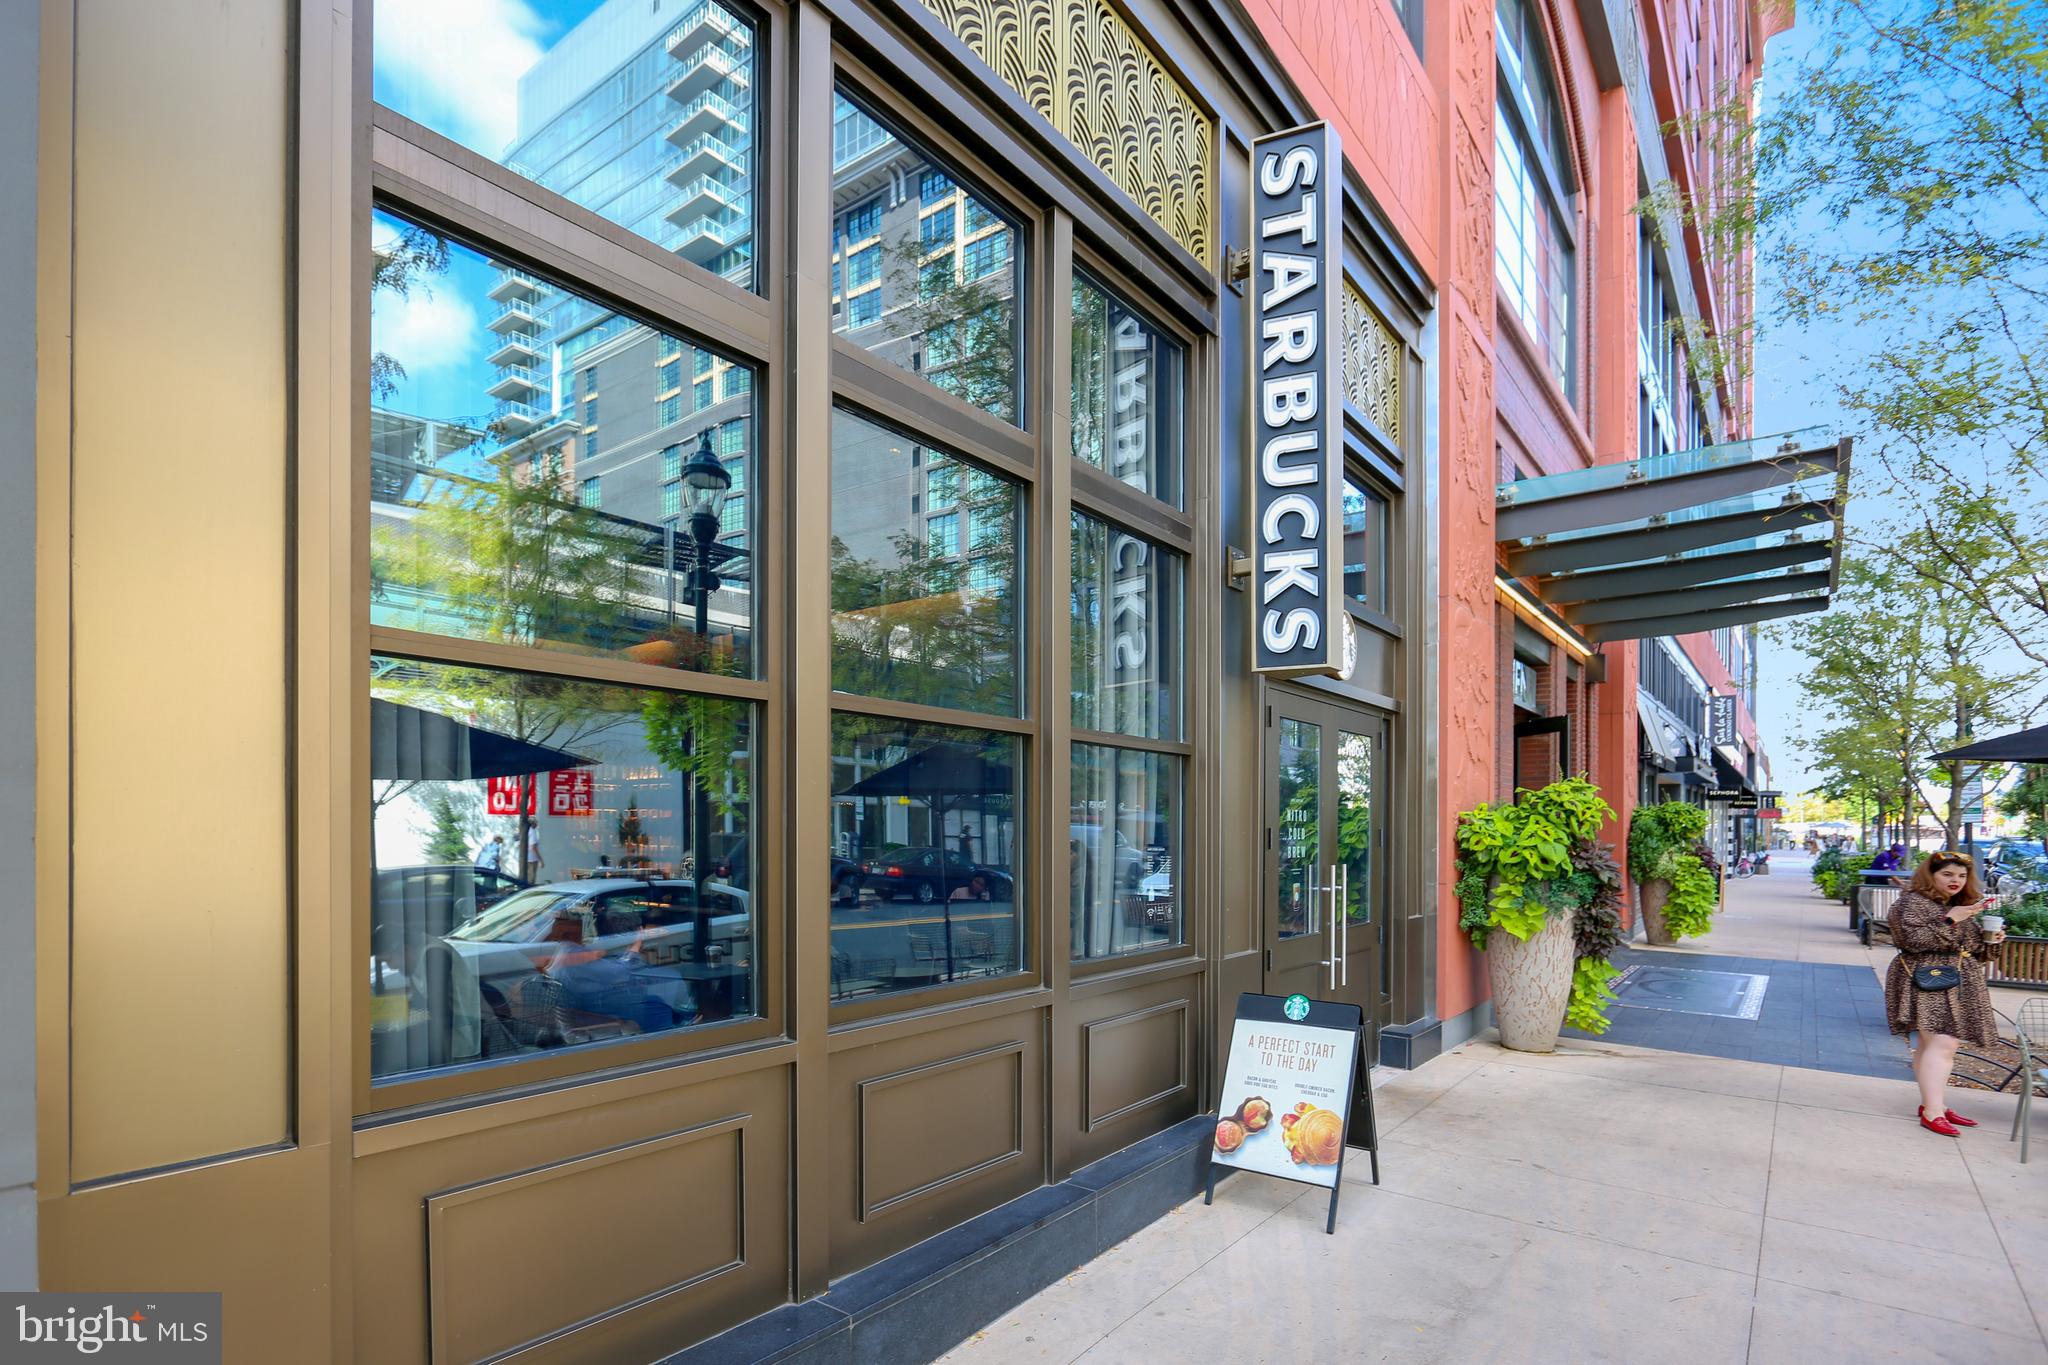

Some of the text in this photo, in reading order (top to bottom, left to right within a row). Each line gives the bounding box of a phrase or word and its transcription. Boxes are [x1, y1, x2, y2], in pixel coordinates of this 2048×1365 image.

[1261, 145, 1321, 653] STARBUCKS
[1286, 809, 1307, 822] NITRO
[1288, 827, 1306, 840] COLD
[1287, 846, 1306, 859] BREW
[1248, 1034, 1337, 1059] A PERFECT START
[1261, 1051, 1318, 1073] TO THE DAY
